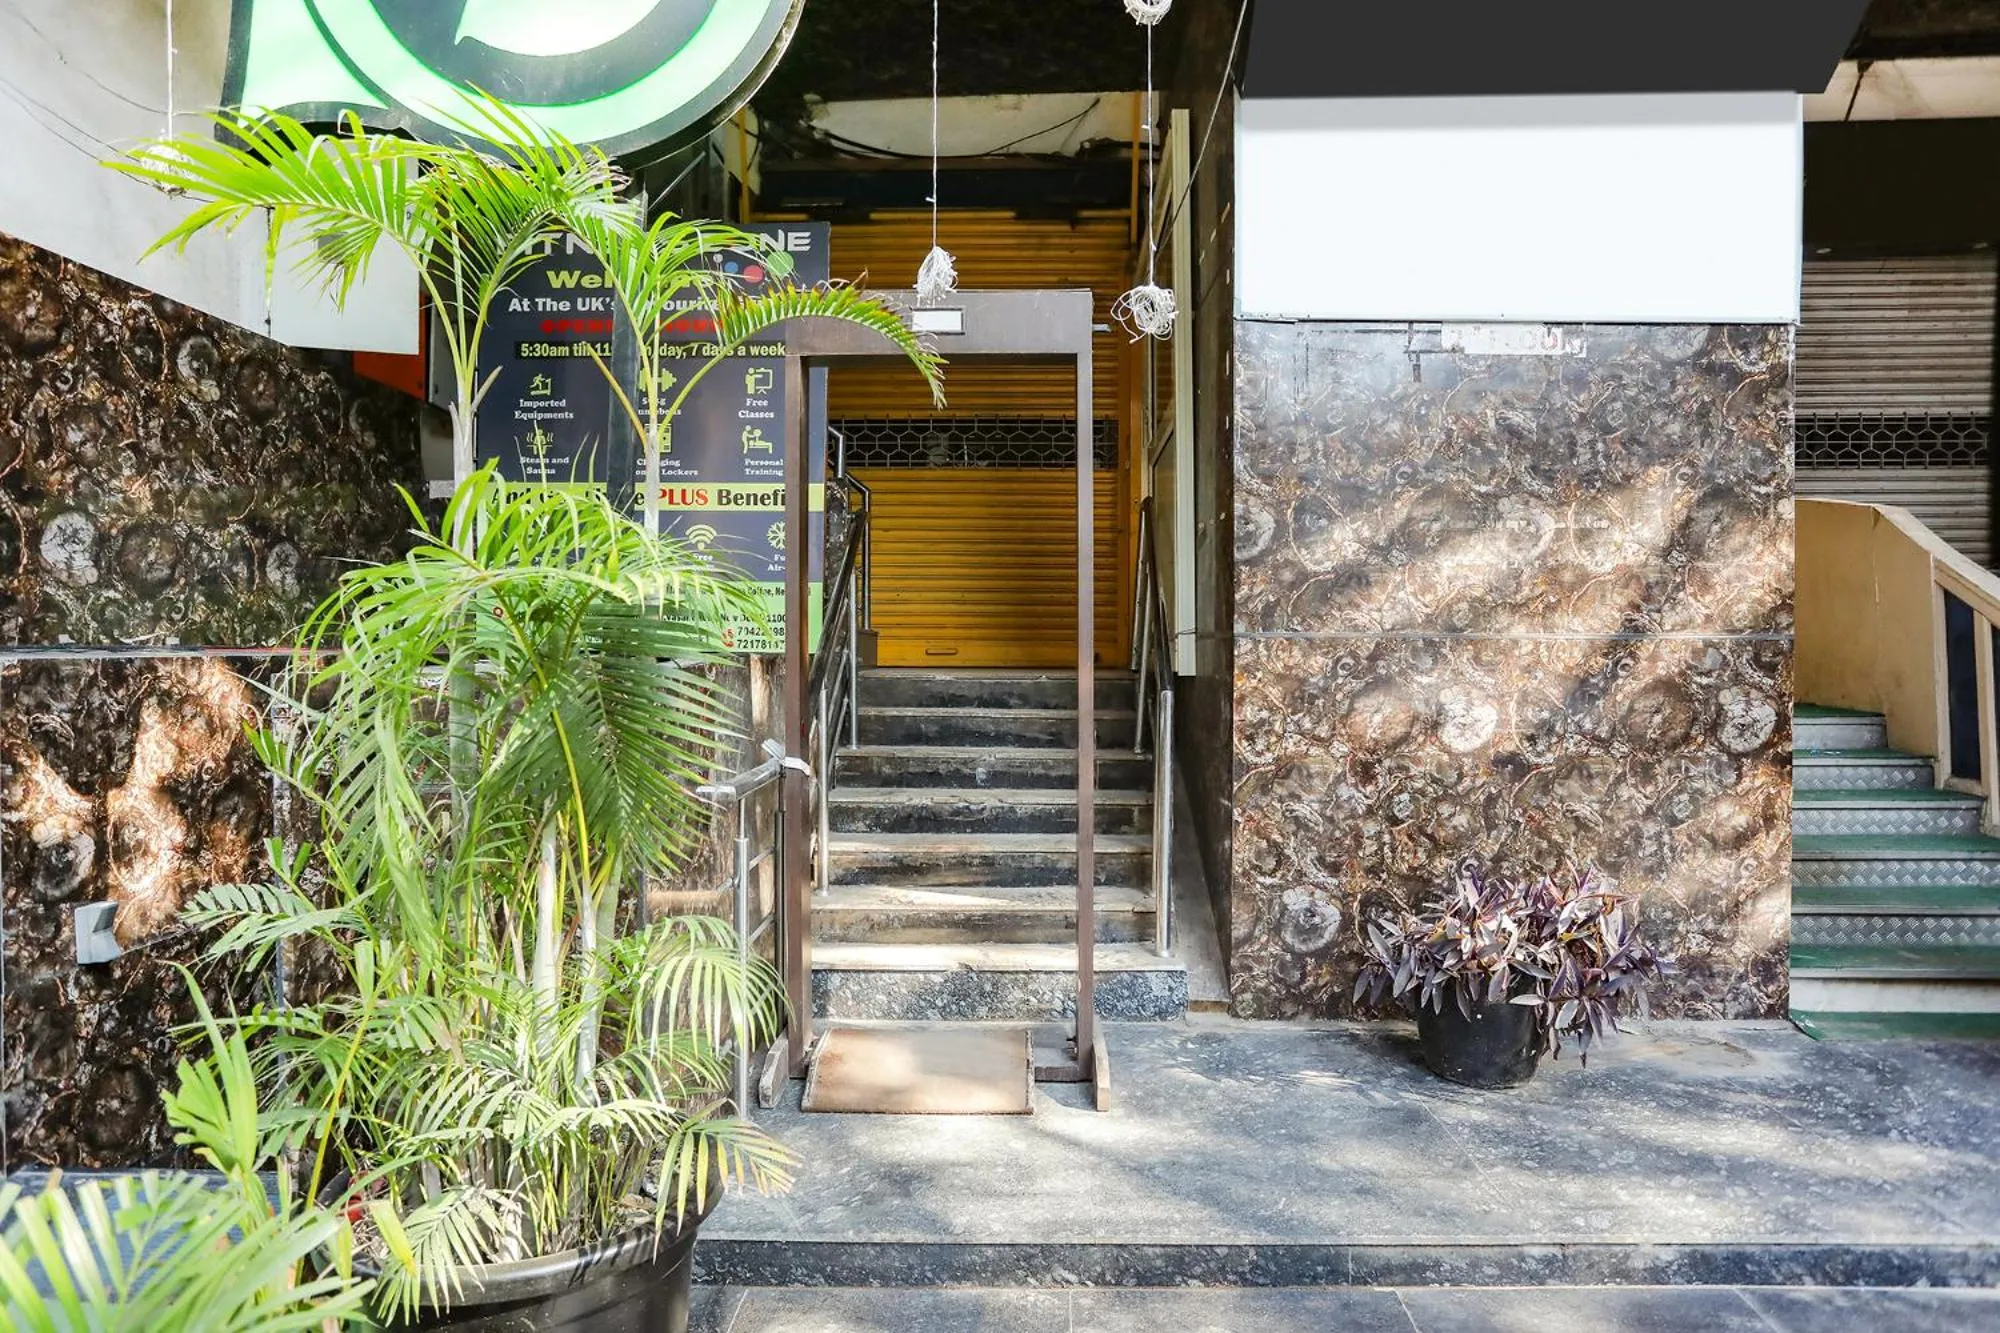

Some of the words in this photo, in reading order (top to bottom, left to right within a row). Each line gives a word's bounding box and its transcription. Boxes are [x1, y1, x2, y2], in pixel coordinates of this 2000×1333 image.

[508, 298, 531, 312] At
[535, 297, 571, 312] The
[521, 343, 569, 357] 5:30am
[737, 346, 746, 356] a
[750, 342, 785, 356] week
[519, 399, 566, 408] Imported
[746, 398, 769, 407] Free
[514, 410, 574, 420] Equipments
[738, 410, 775, 419] Classes
[744, 458, 783, 466] Personal
[744, 468, 783, 477] Training
[716, 489, 785, 506] Benefi
